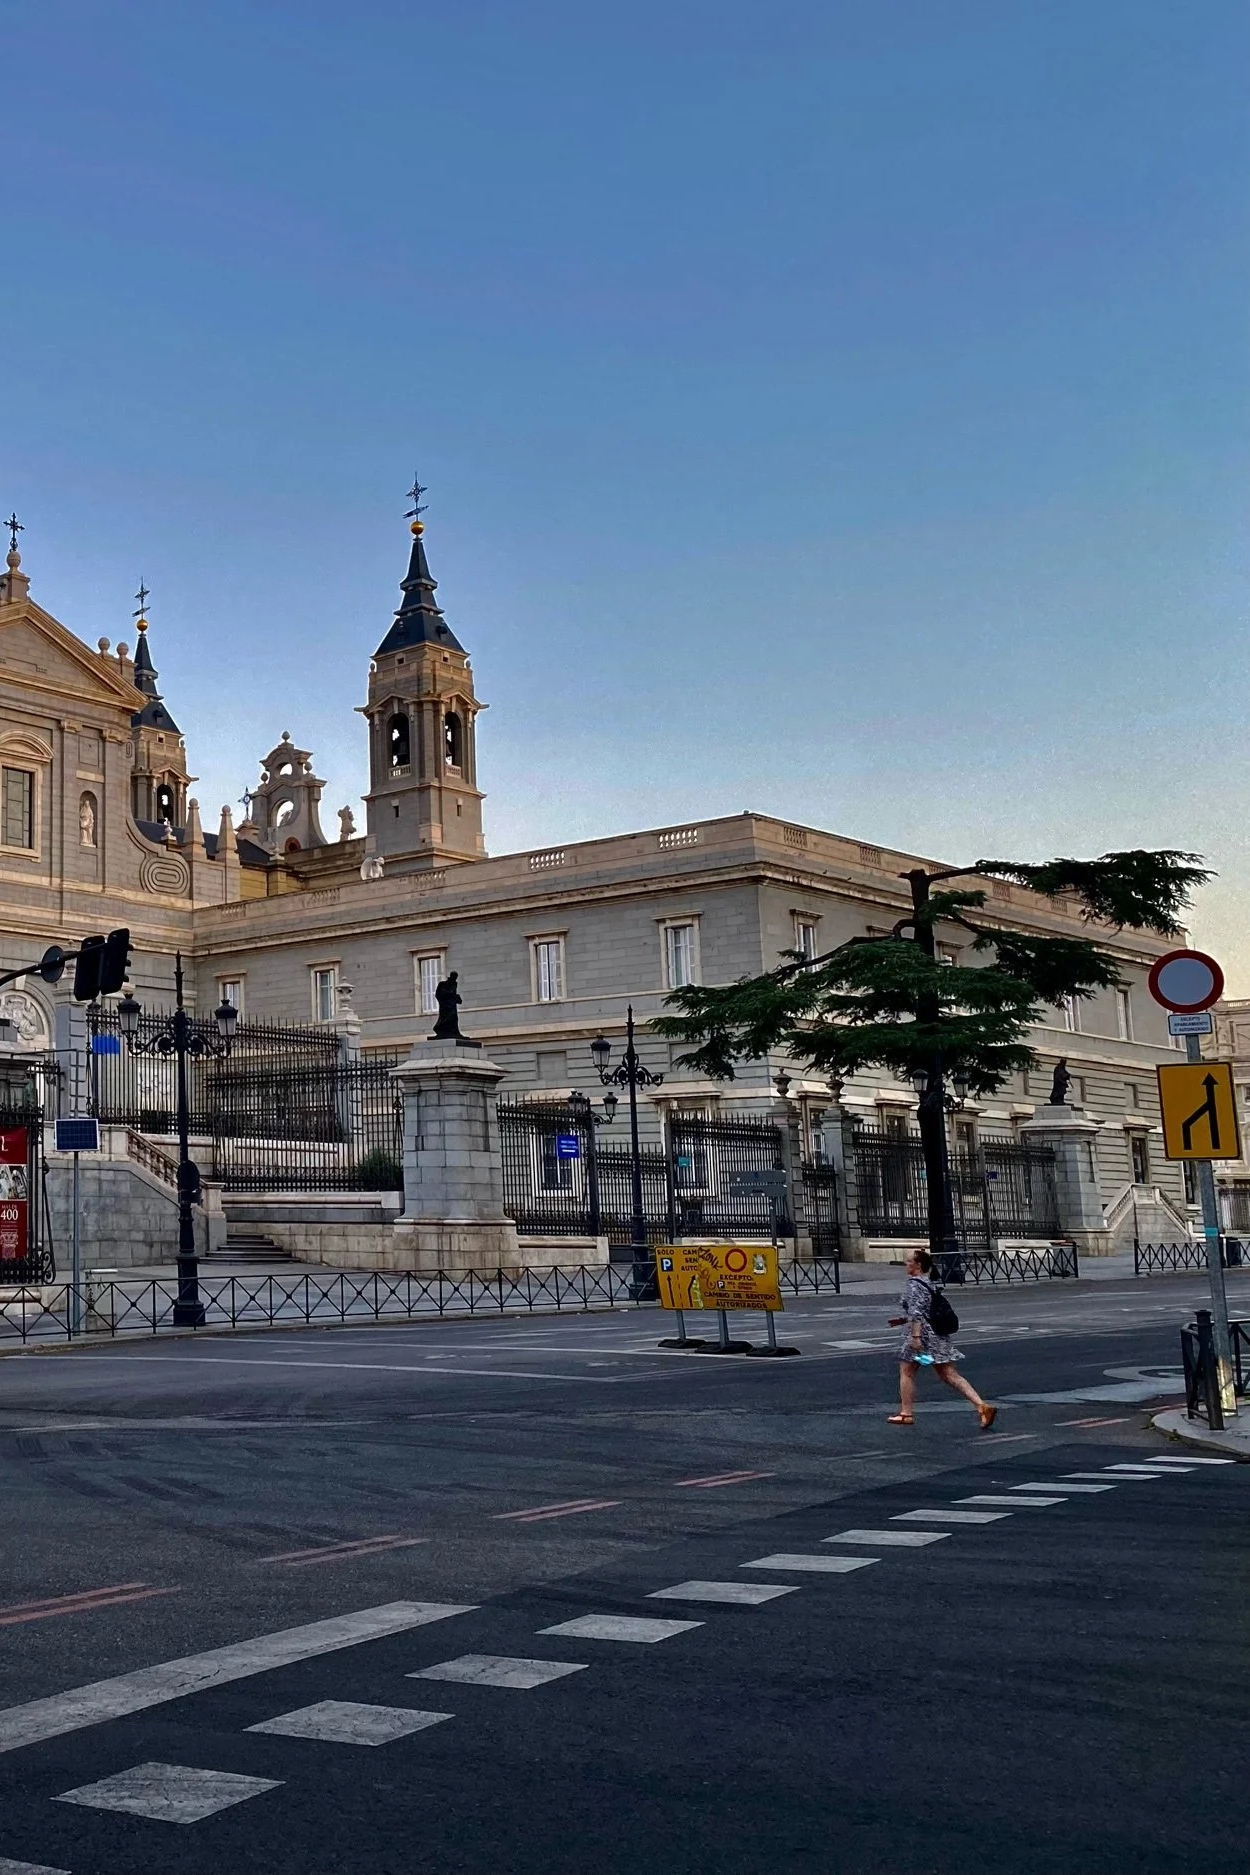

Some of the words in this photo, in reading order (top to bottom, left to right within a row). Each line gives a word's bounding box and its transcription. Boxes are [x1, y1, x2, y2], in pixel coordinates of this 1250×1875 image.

[0, 1208, 19, 1221] 400
[662, 1258, 672, 1271] P
[704, 1291, 730, 1299] CAMBIO
[716, 1300, 768, 1309] AUTORIZADOS
